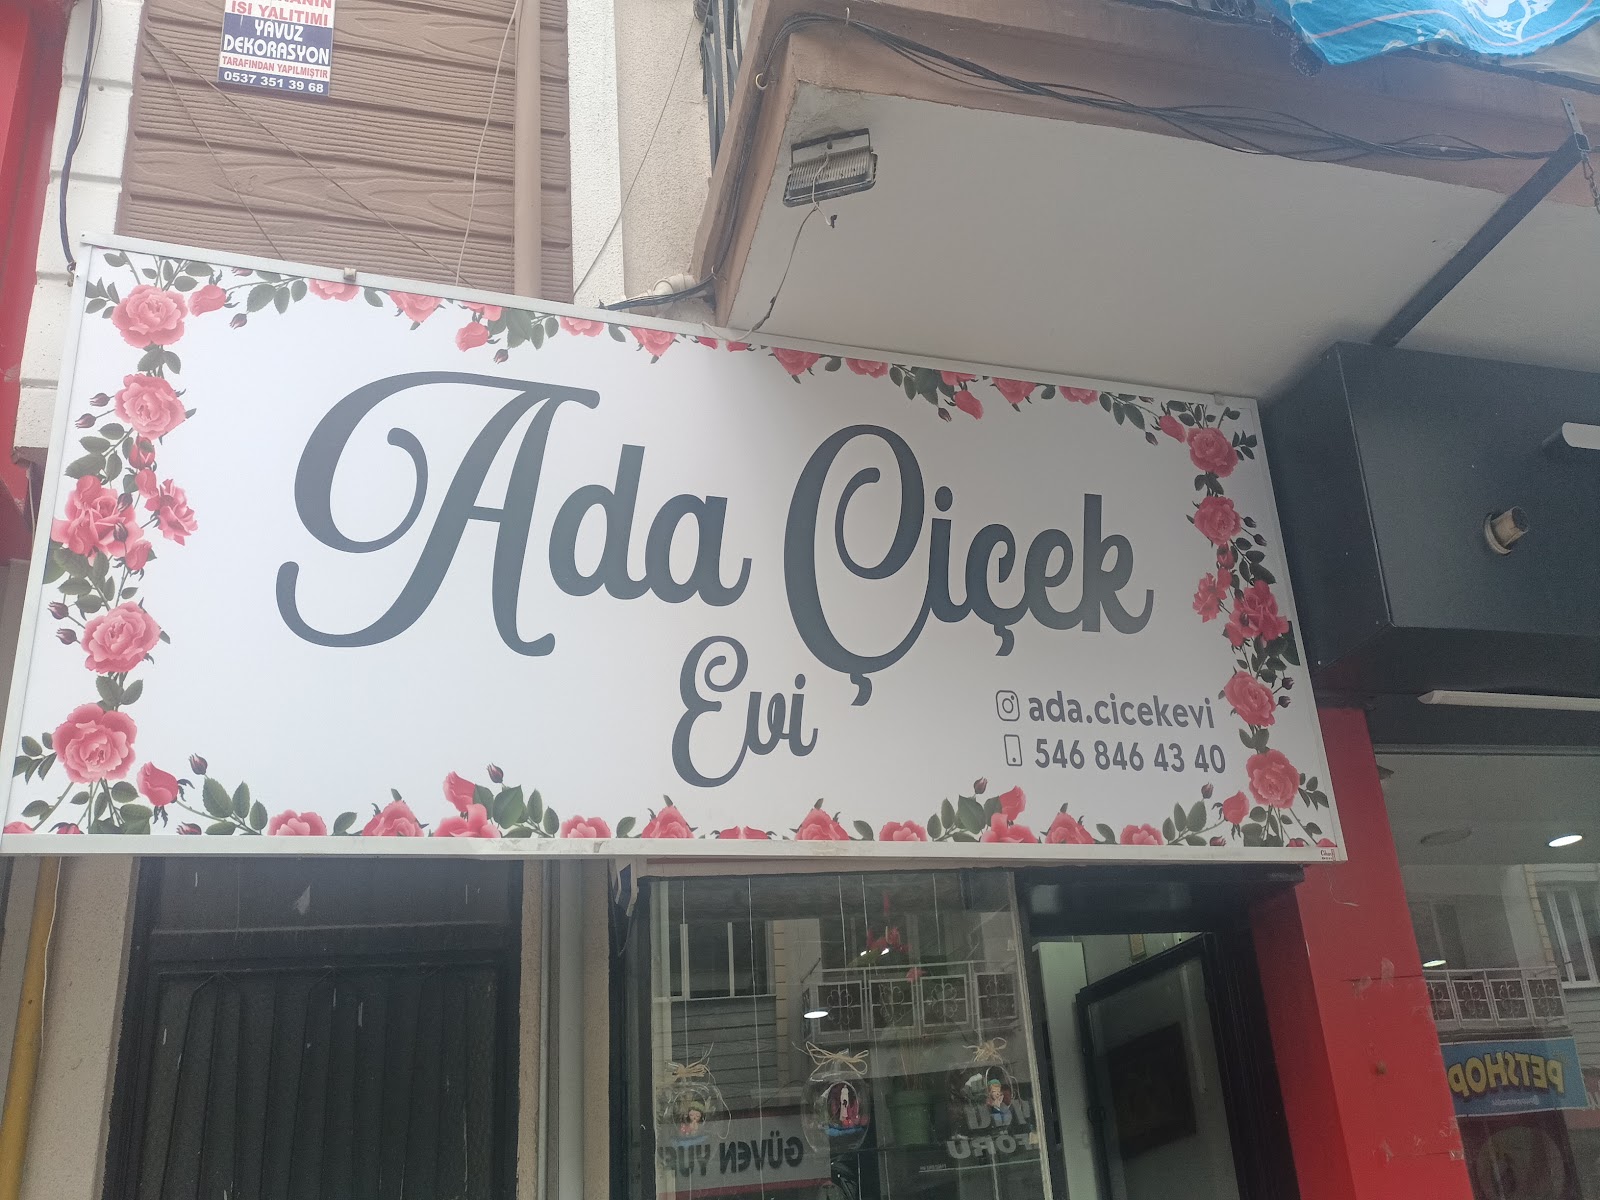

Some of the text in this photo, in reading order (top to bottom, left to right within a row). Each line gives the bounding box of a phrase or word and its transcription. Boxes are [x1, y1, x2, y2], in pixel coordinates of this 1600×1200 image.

[231, 1, 328, 26] ISI YALITIMI
[254, 19, 304, 42] YAVUZ
[223, 34, 330, 65] DEKORASYON
[222, 56, 329, 79] TARAFINDAN YAPILMIŞTIR
[224, 71, 324, 93] 0537 351 39 68
[276, 371, 1154, 706] Ada Çiçek
[672, 636, 818, 788] Evi
[1028, 690, 1215, 728] ada.cicekevi
[1034, 738, 1226, 774] 546 846 43 40
